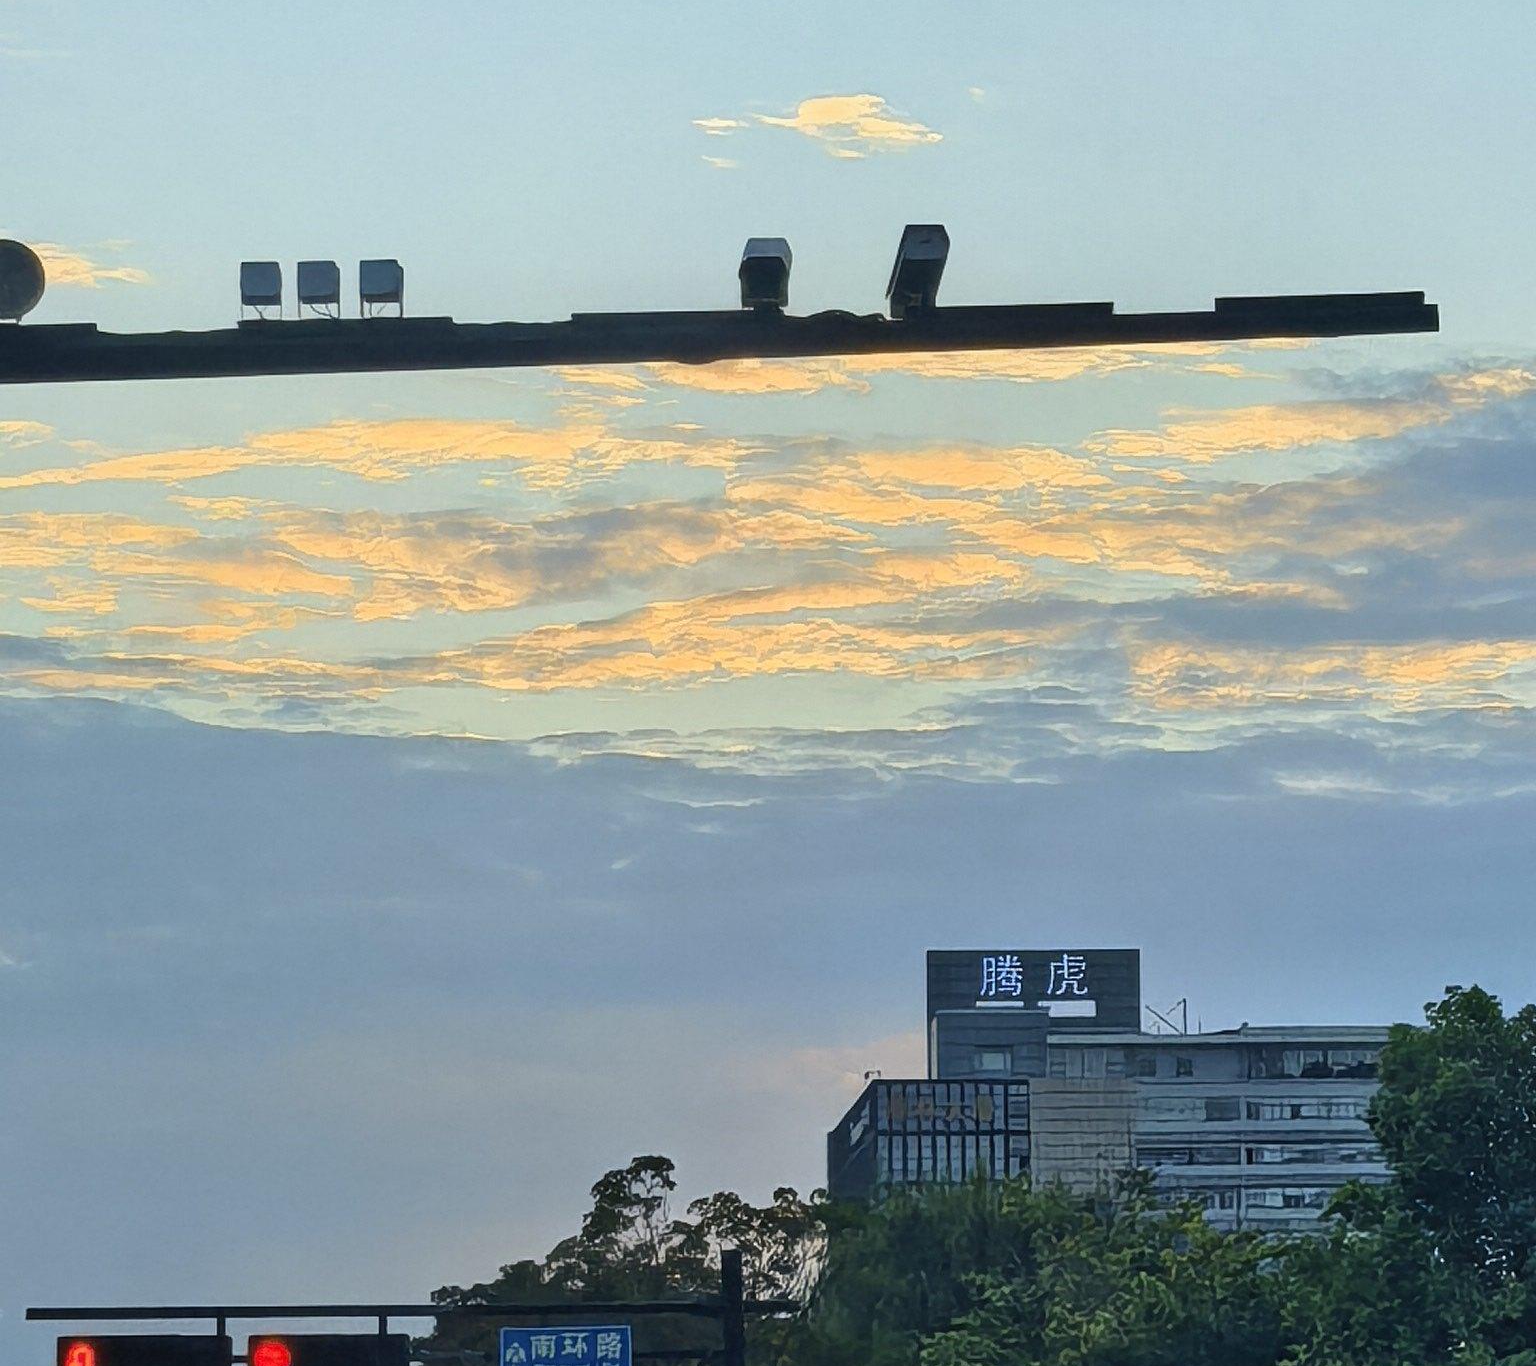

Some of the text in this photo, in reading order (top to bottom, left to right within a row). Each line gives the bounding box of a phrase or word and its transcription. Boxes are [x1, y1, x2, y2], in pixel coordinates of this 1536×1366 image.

[979, 953, 1089, 997] 腾虎
[530, 1332, 622, 1360] 南环路
